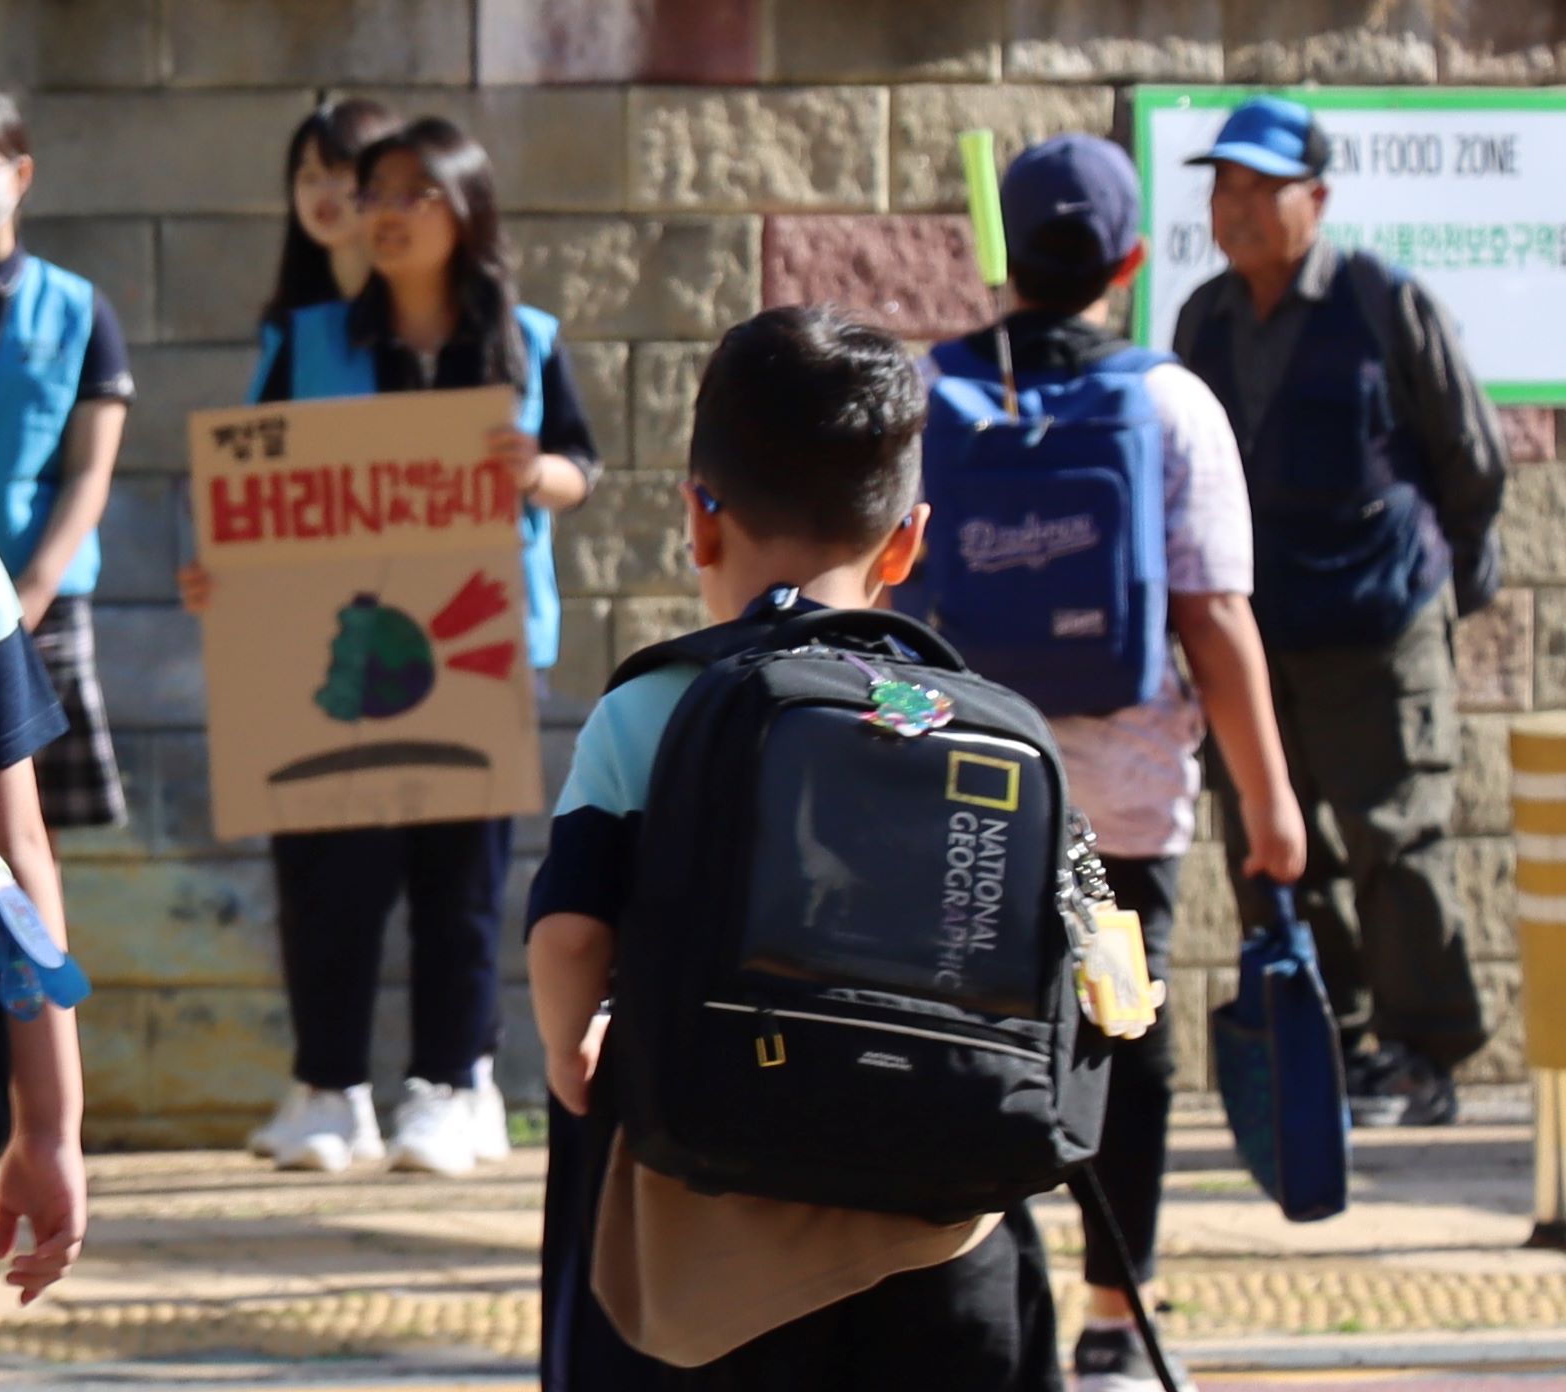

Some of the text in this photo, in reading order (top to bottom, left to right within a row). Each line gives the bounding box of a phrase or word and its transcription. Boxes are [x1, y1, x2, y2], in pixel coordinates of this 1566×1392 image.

[1371, 133, 1442, 175] FOOD
[1455, 133, 1519, 175] ZONE
[934, 811, 979, 990] GEOGRAPHIC
[967, 818, 1009, 954] NATIONAL
